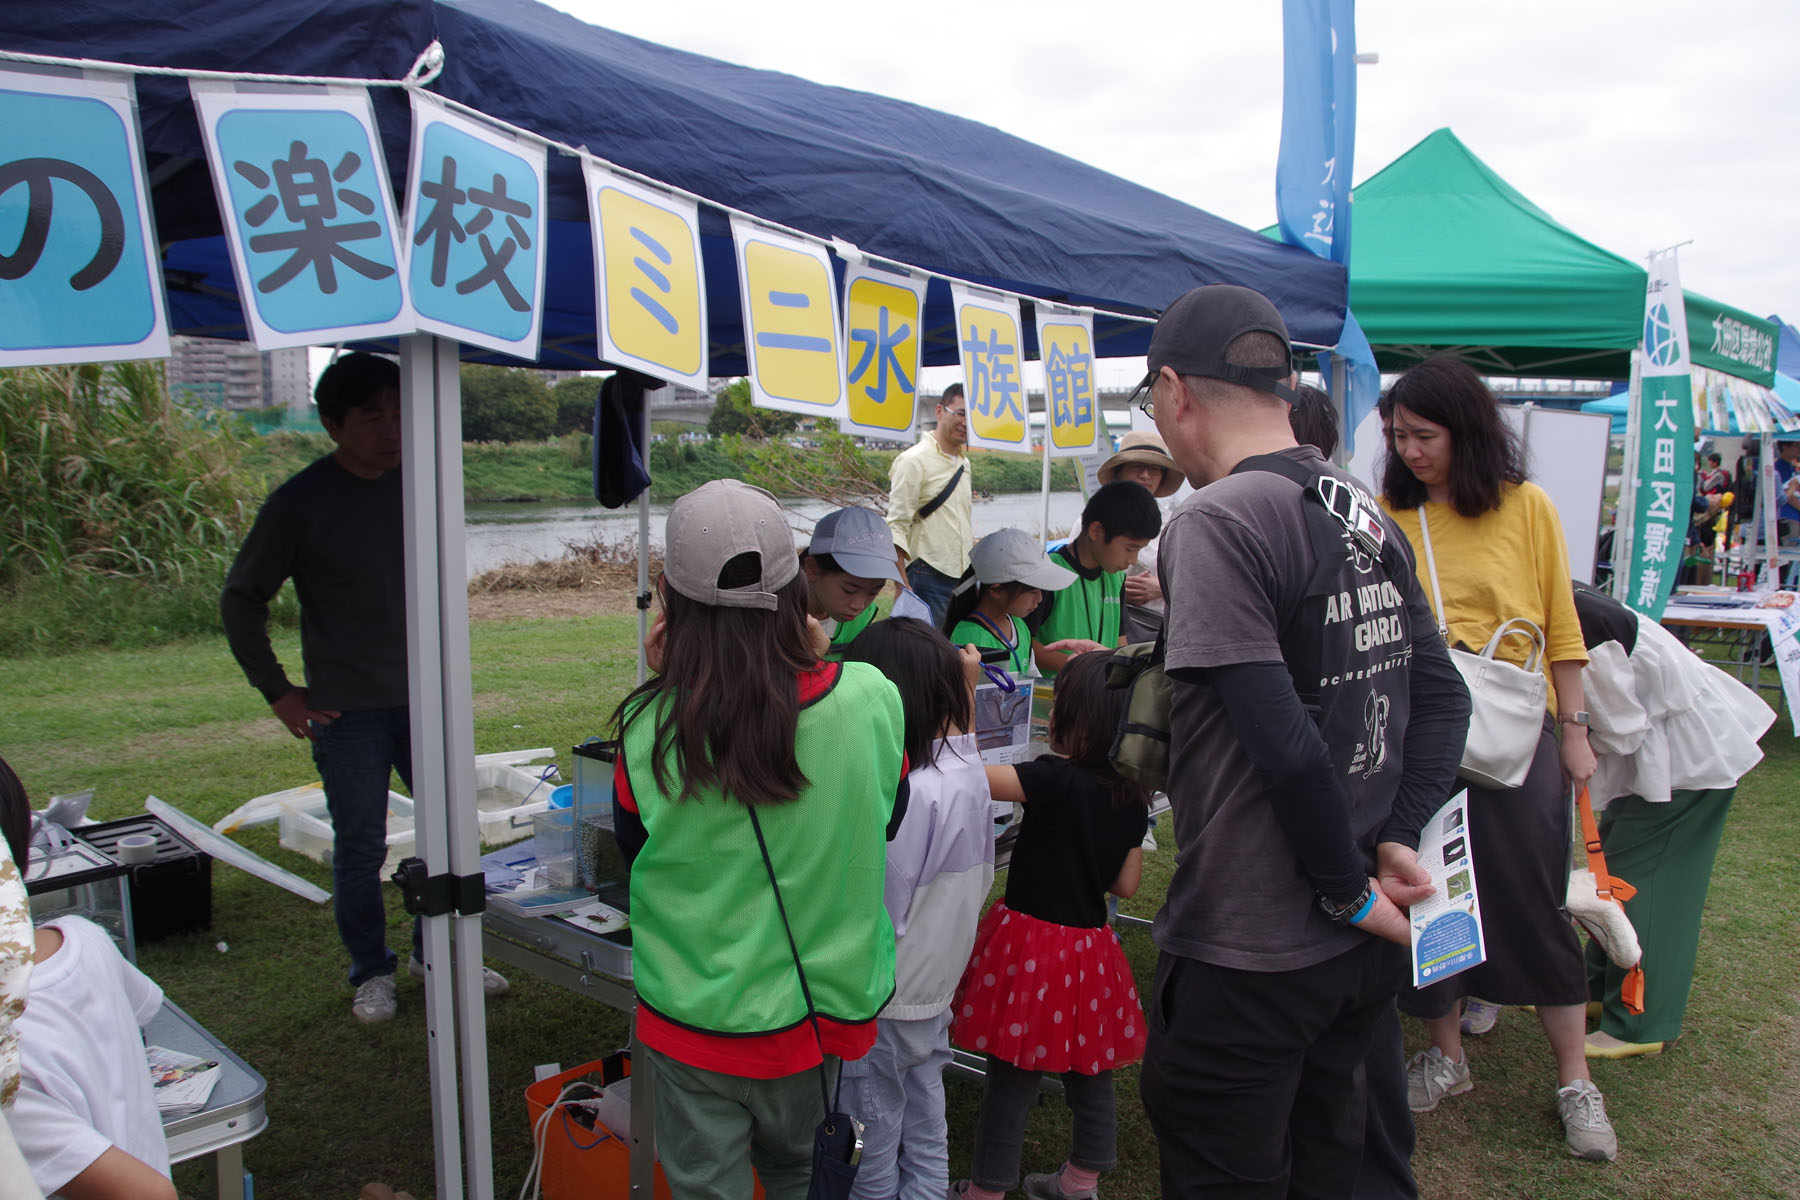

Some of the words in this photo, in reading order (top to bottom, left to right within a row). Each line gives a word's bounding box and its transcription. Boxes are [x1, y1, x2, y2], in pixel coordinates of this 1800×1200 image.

[629, 227, 1094, 428] ミニ水族館
